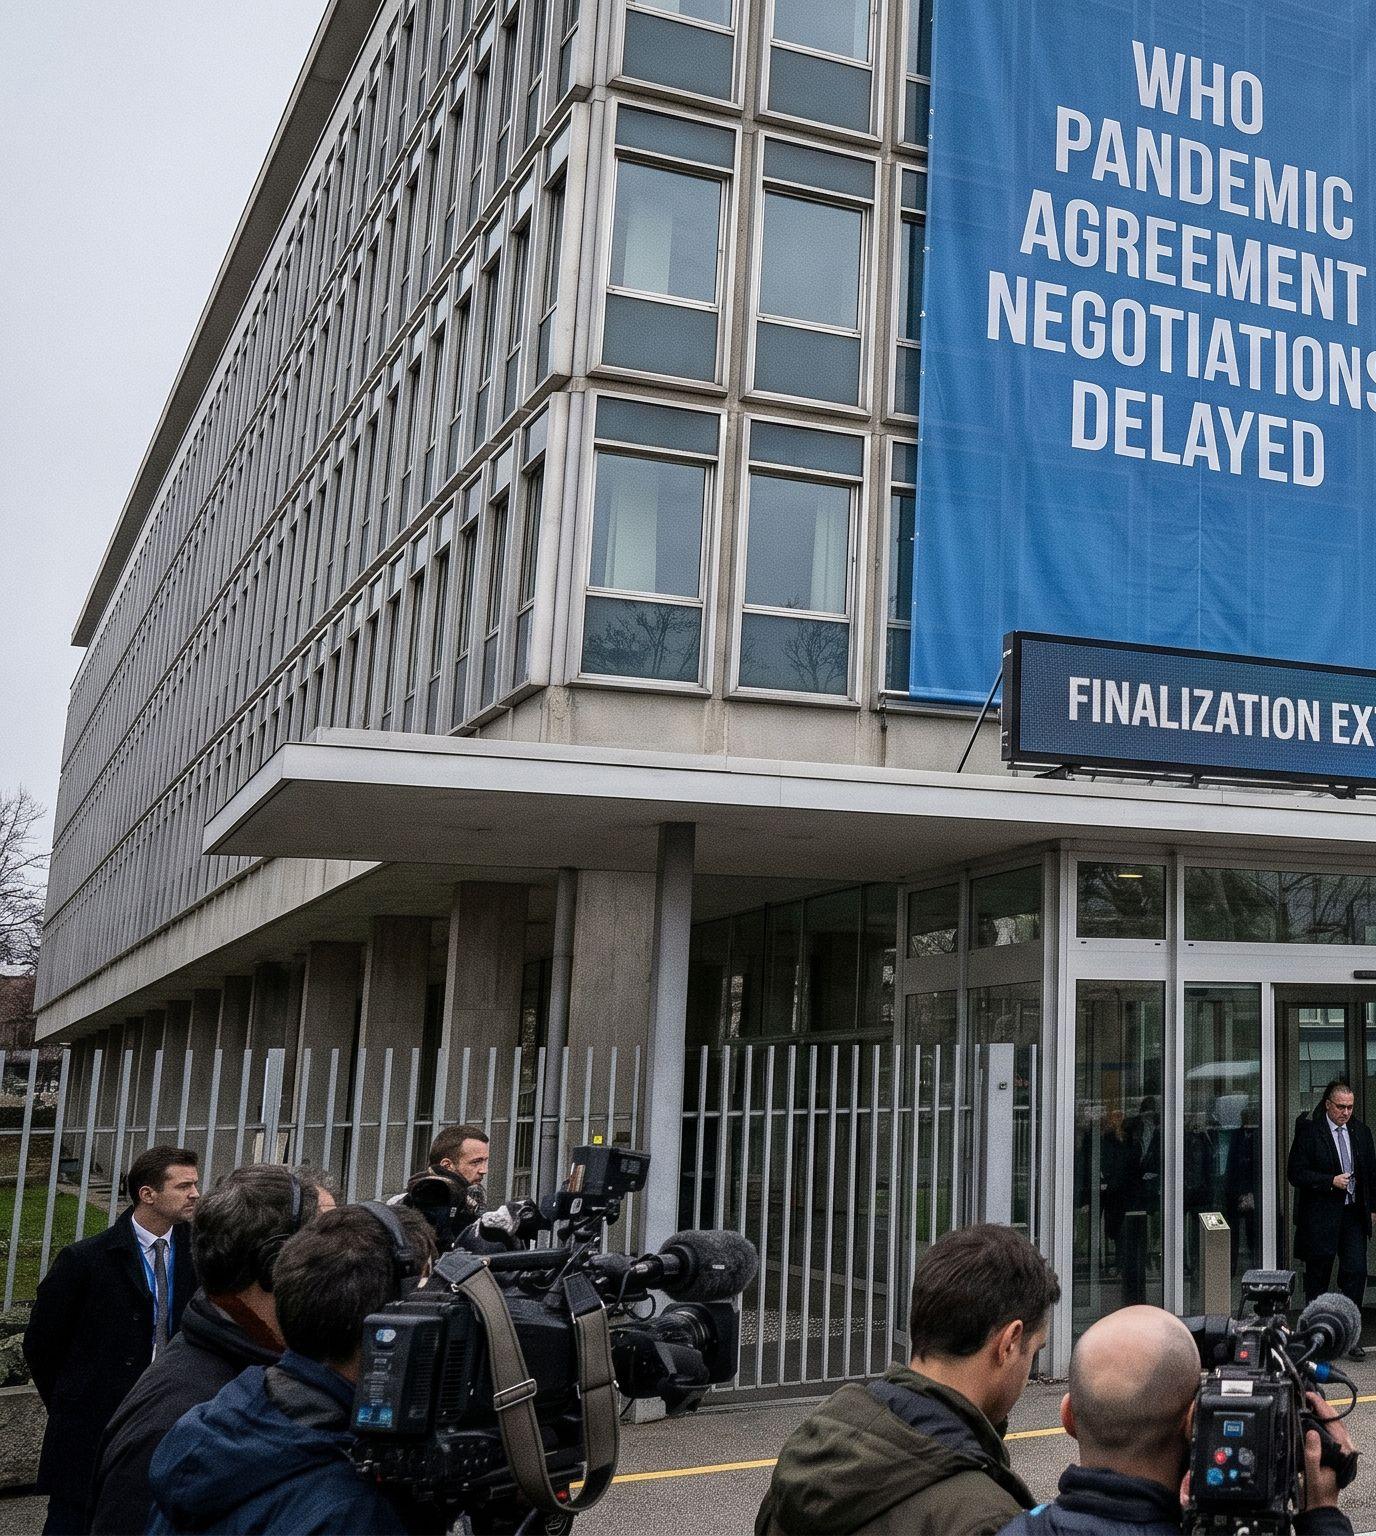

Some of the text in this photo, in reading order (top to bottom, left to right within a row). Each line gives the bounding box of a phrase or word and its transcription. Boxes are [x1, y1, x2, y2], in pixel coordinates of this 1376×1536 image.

[1132, 40, 1263, 135] WHO
[1055, 105, 1353, 240] PANDEMIC
[1020, 189, 1367, 326] AGREEMENT
[1071, 379, 1325, 487] DELAYED
[1068, 676, 1320, 742] FINALIZATION
